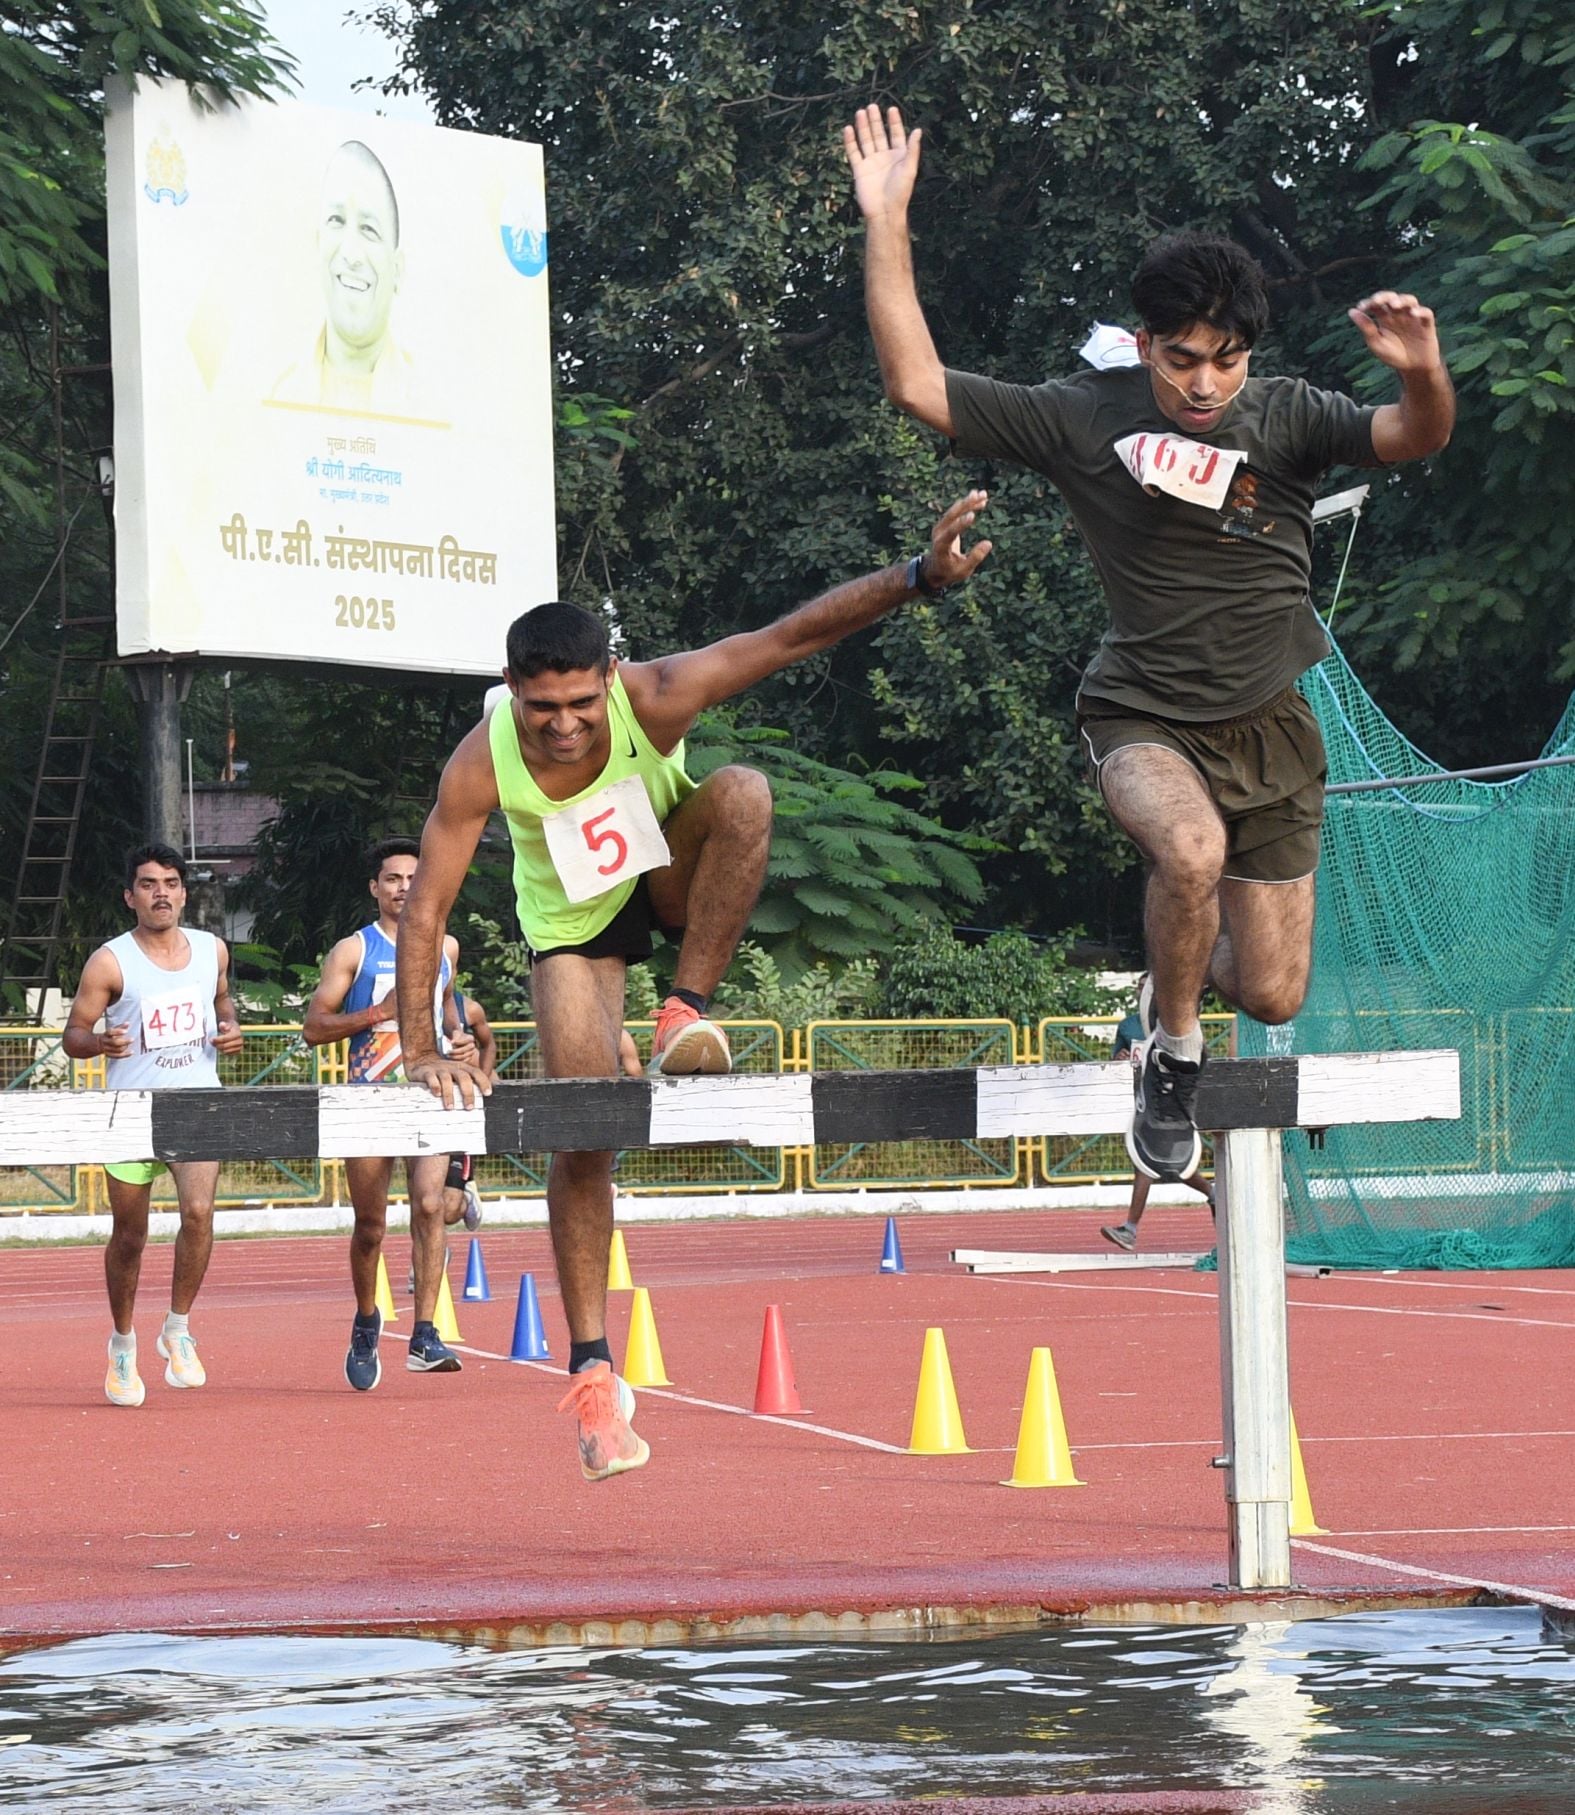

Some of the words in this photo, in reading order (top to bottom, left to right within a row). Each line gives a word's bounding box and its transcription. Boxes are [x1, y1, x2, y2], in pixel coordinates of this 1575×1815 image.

[306, 456, 318, 479] श्री
[321, 458, 344, 480] योगी
[347, 462, 402, 487] आदित्यनाथ
[220, 512, 320, 567] पी.ए.सी.
[324, 524, 434, 578] संस्थापना
[438, 534, 497, 585] दिवस
[335, 595, 396, 631] 2025
[581, 807, 628, 876] 5
[148, 1002, 196, 1037] 473
[155, 1053, 194, 1070] EXPLORER
